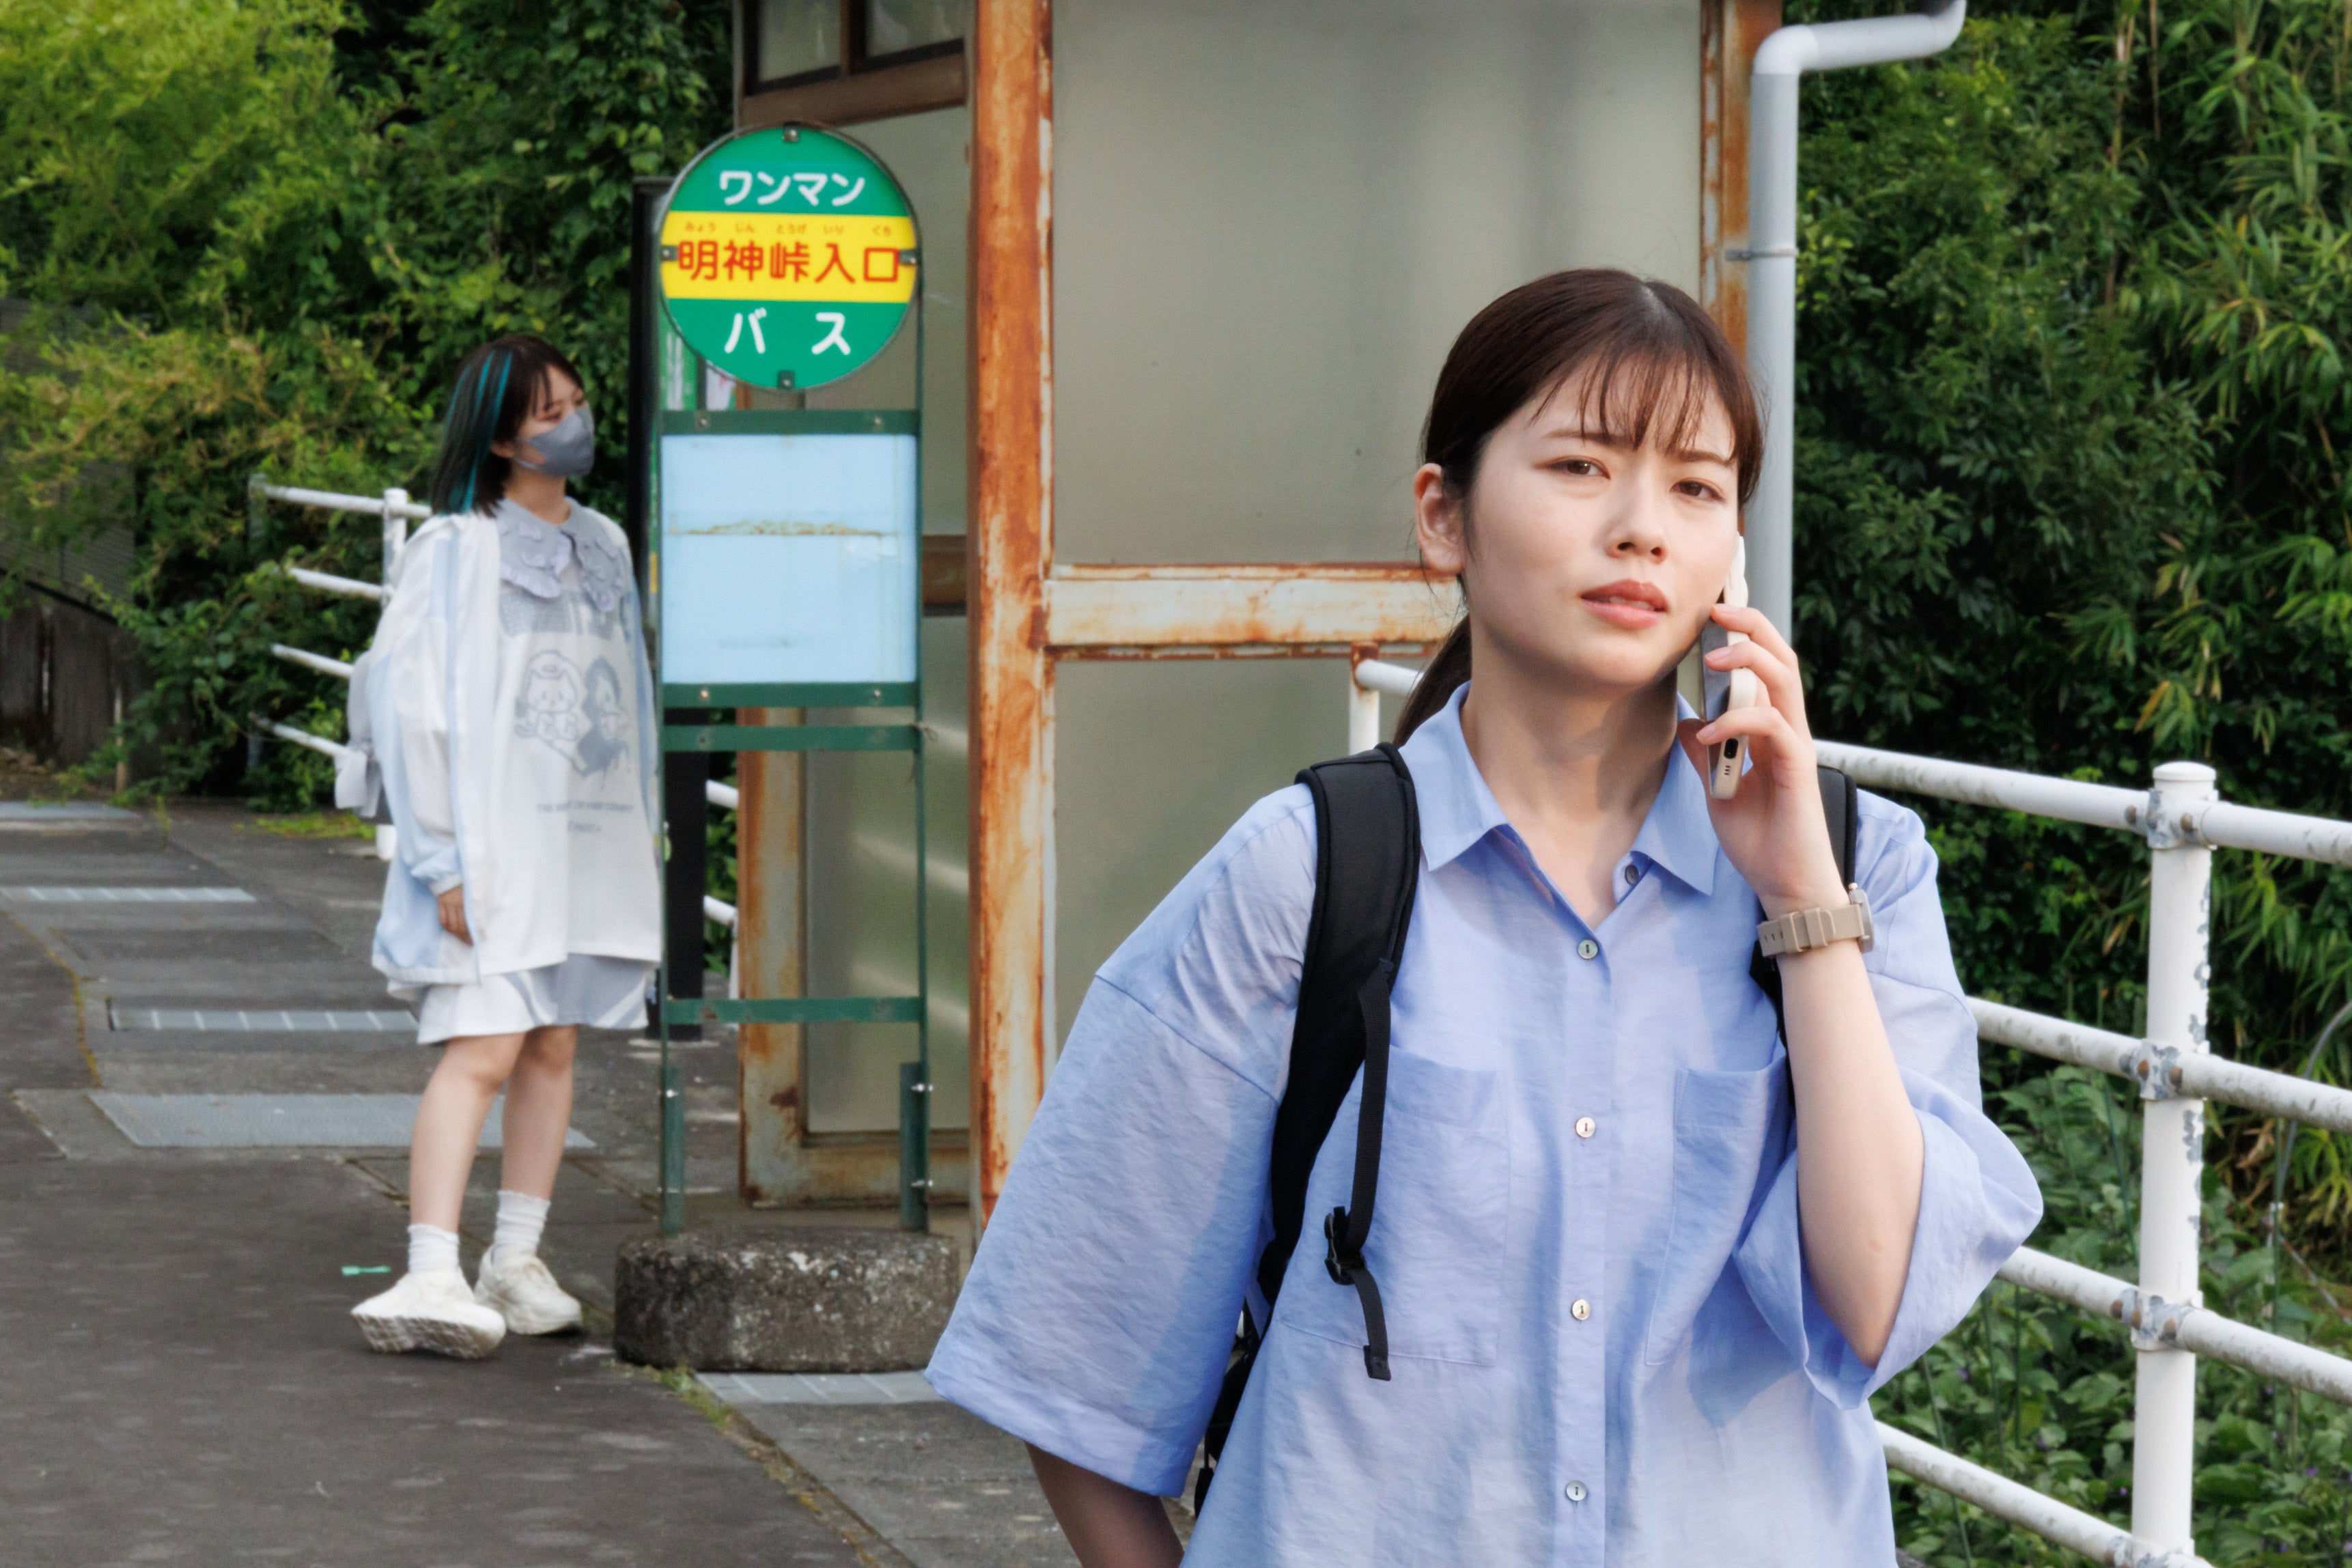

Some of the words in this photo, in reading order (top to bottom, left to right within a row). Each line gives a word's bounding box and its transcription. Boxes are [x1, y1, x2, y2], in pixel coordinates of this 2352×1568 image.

[719, 170, 865, 206] ワンマン
[677, 239, 899, 284] 明神峠入口
